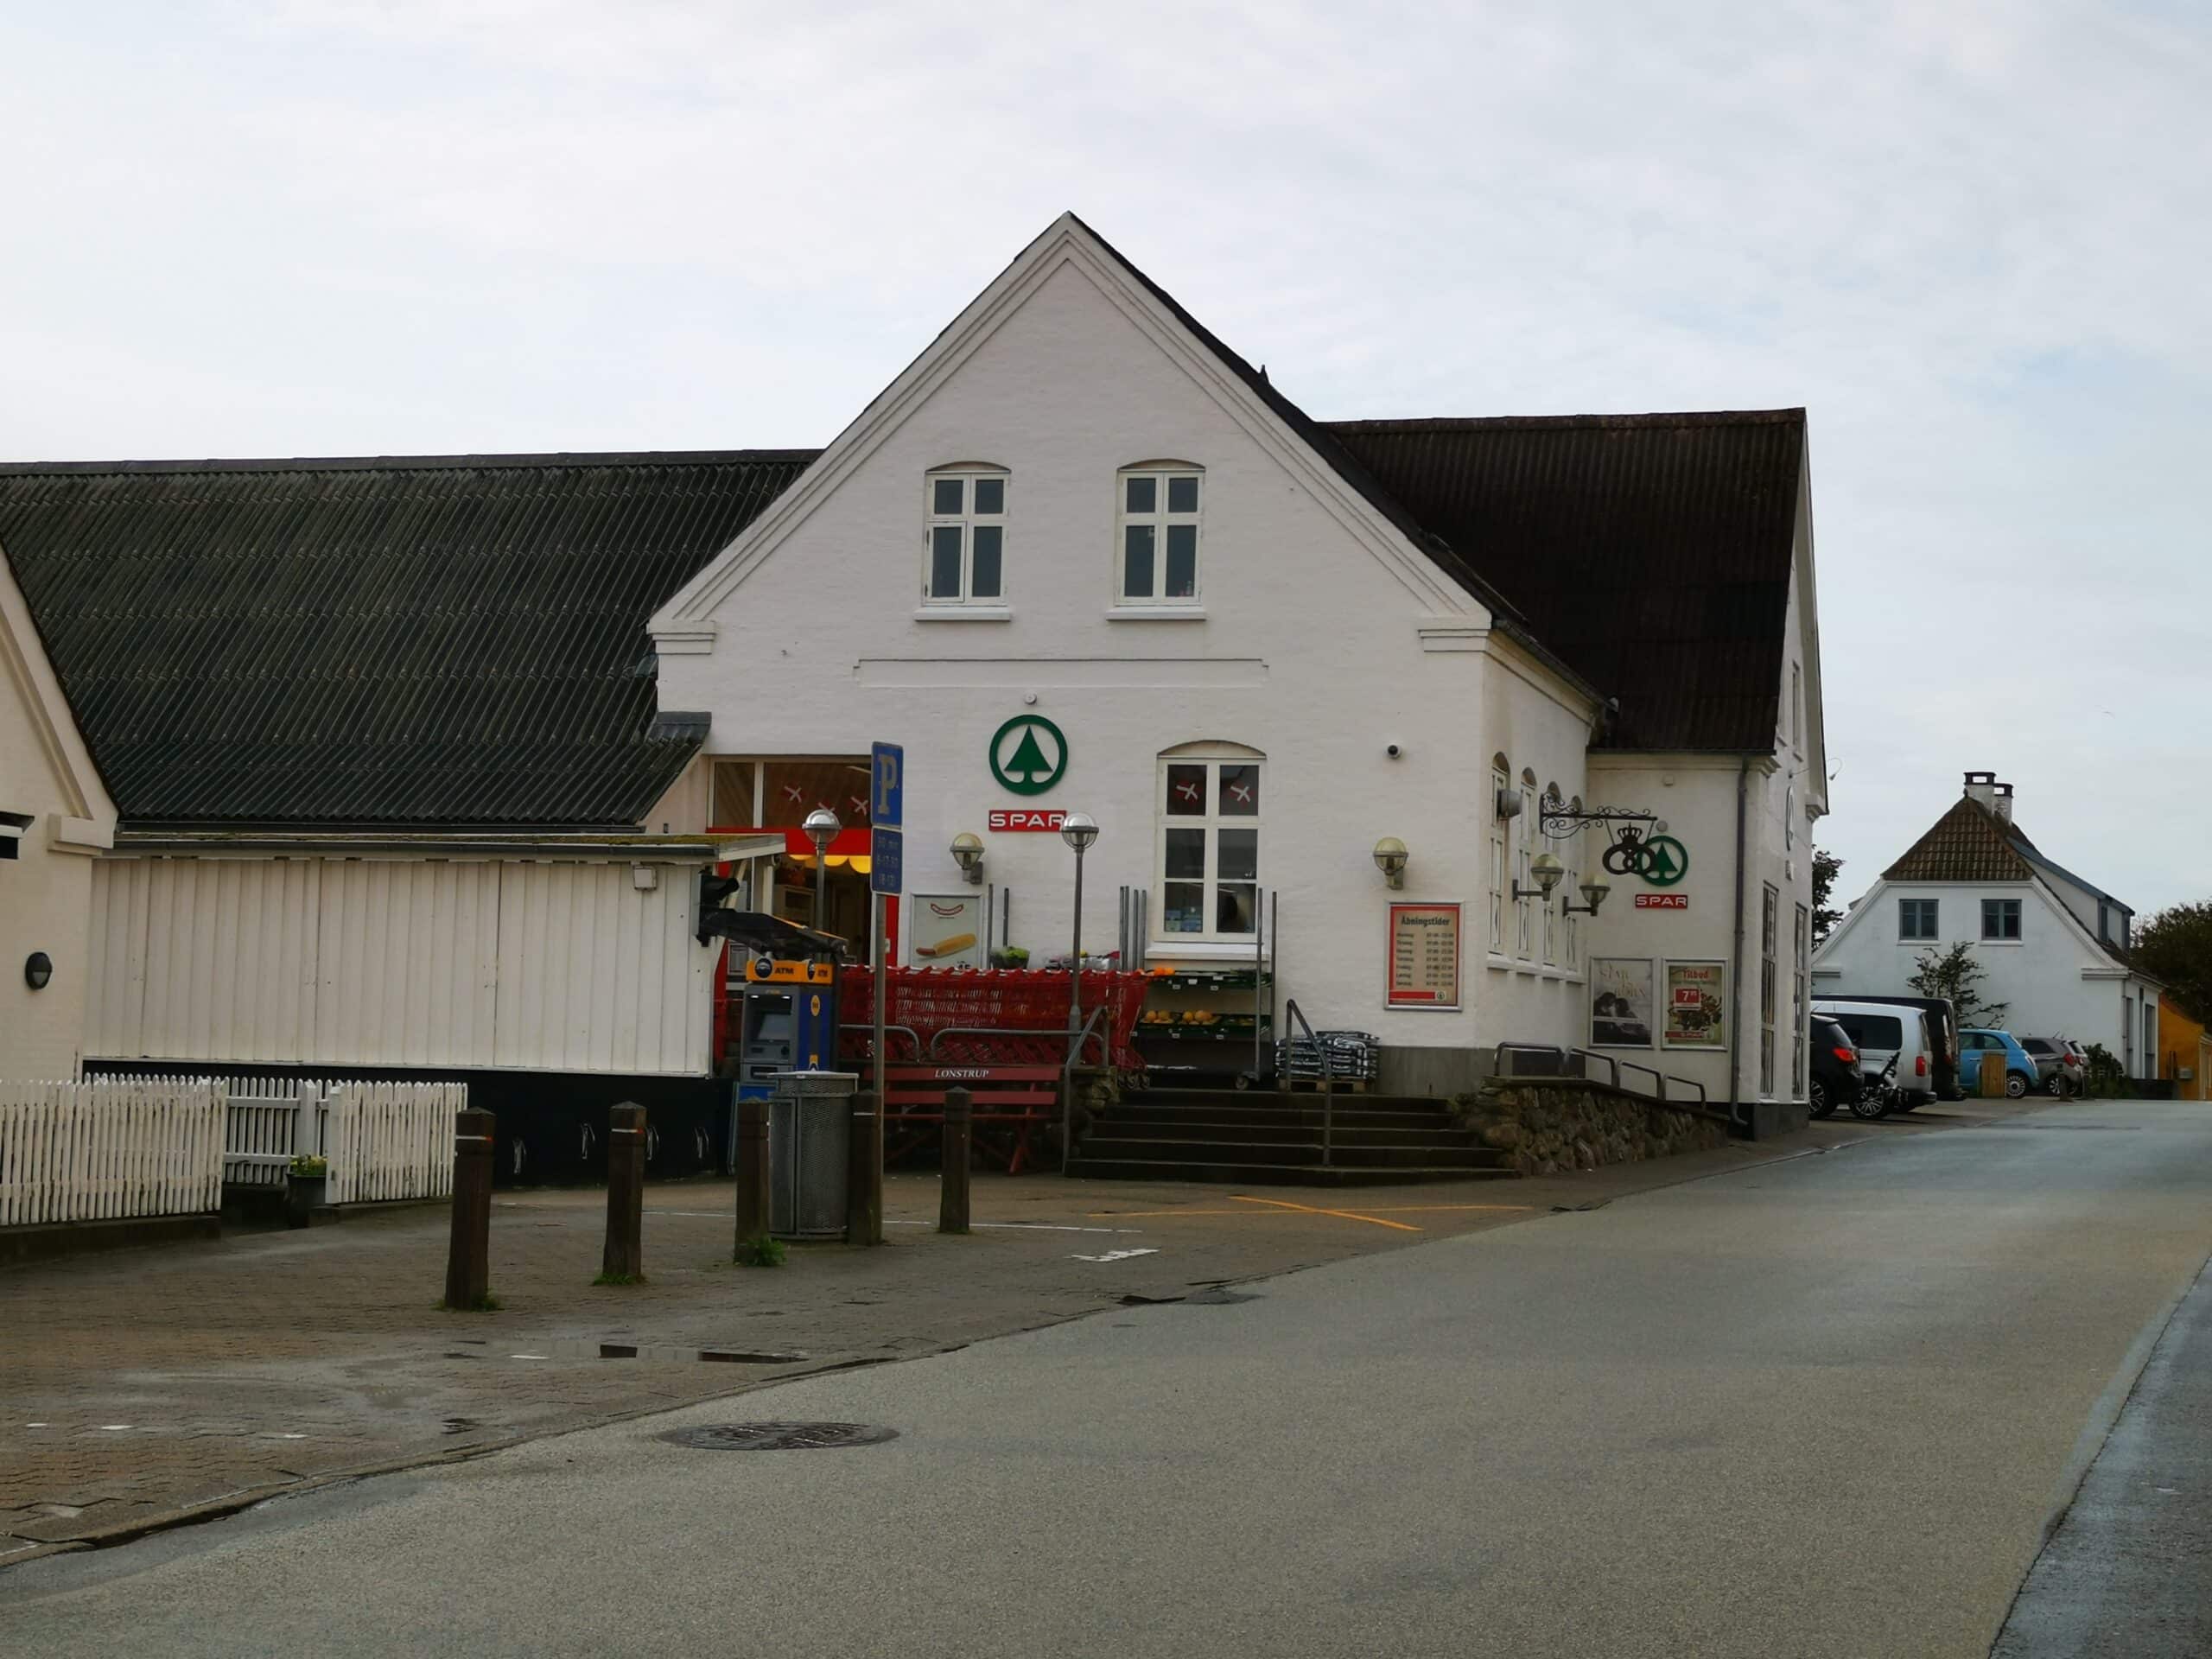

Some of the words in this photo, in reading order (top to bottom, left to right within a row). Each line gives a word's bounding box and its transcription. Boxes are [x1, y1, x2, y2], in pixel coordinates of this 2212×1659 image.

[878, 753, 898, 815] P
[990, 813, 1065, 827] SPAR
[1637, 896, 1687, 906] SPAR
[1683, 969, 1708, 979] Tilbud
